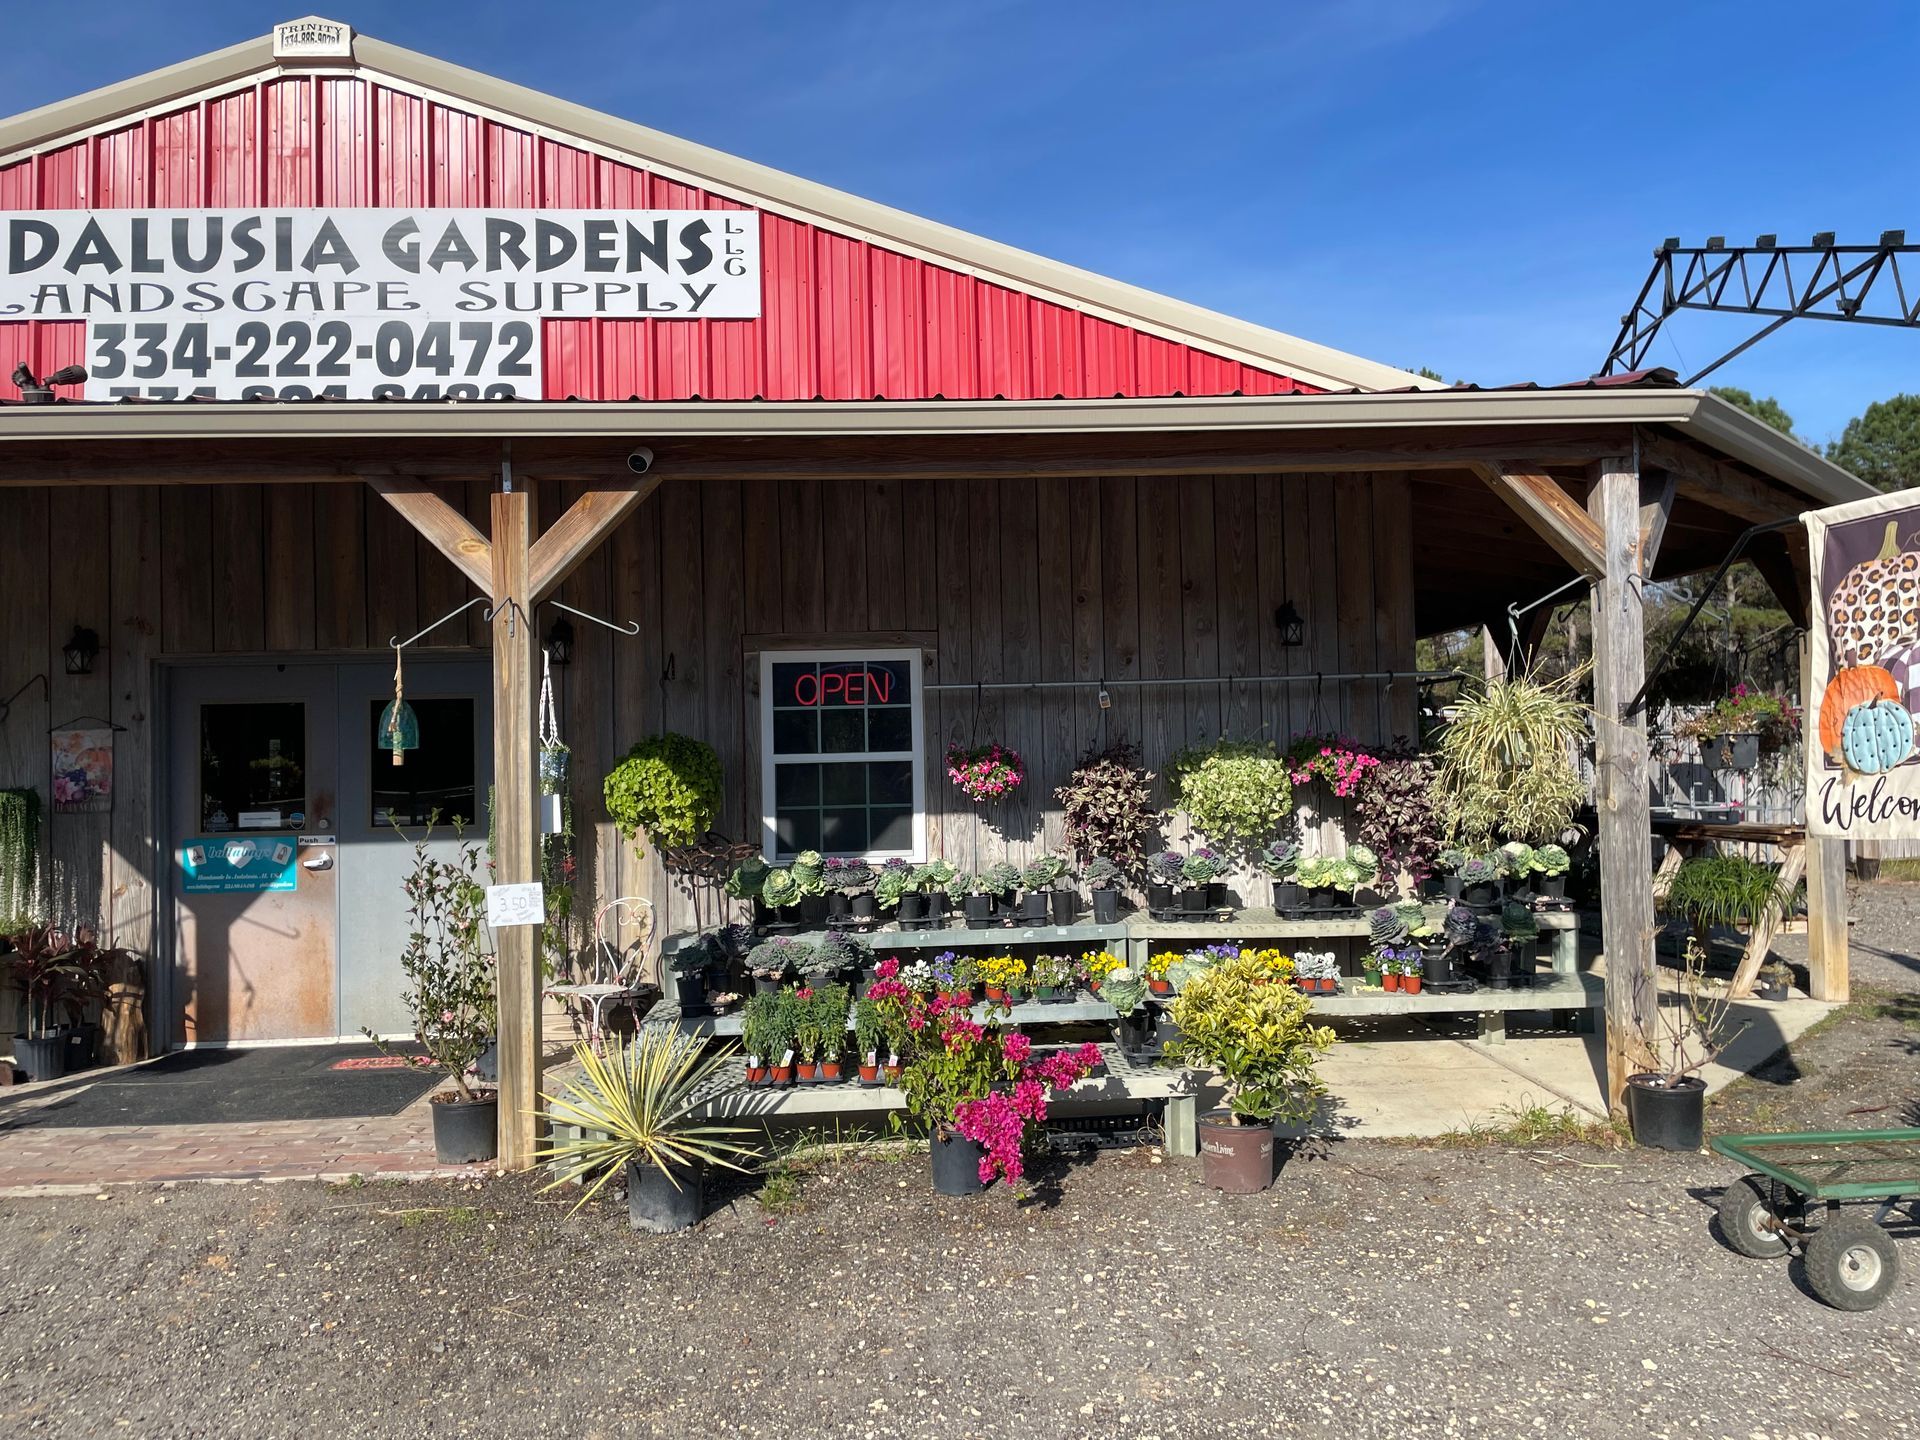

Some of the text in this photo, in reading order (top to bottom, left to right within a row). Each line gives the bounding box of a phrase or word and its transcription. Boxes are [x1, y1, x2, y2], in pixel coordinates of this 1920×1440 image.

[279, 23, 343, 34] TRINITY
[9, 216, 713, 276] DALUSIA GARDENS
[455, 281, 718, 312] SUPPLY
[91, 320, 533, 379] 334-222-0472
[795, 672, 889, 705] OPEN
